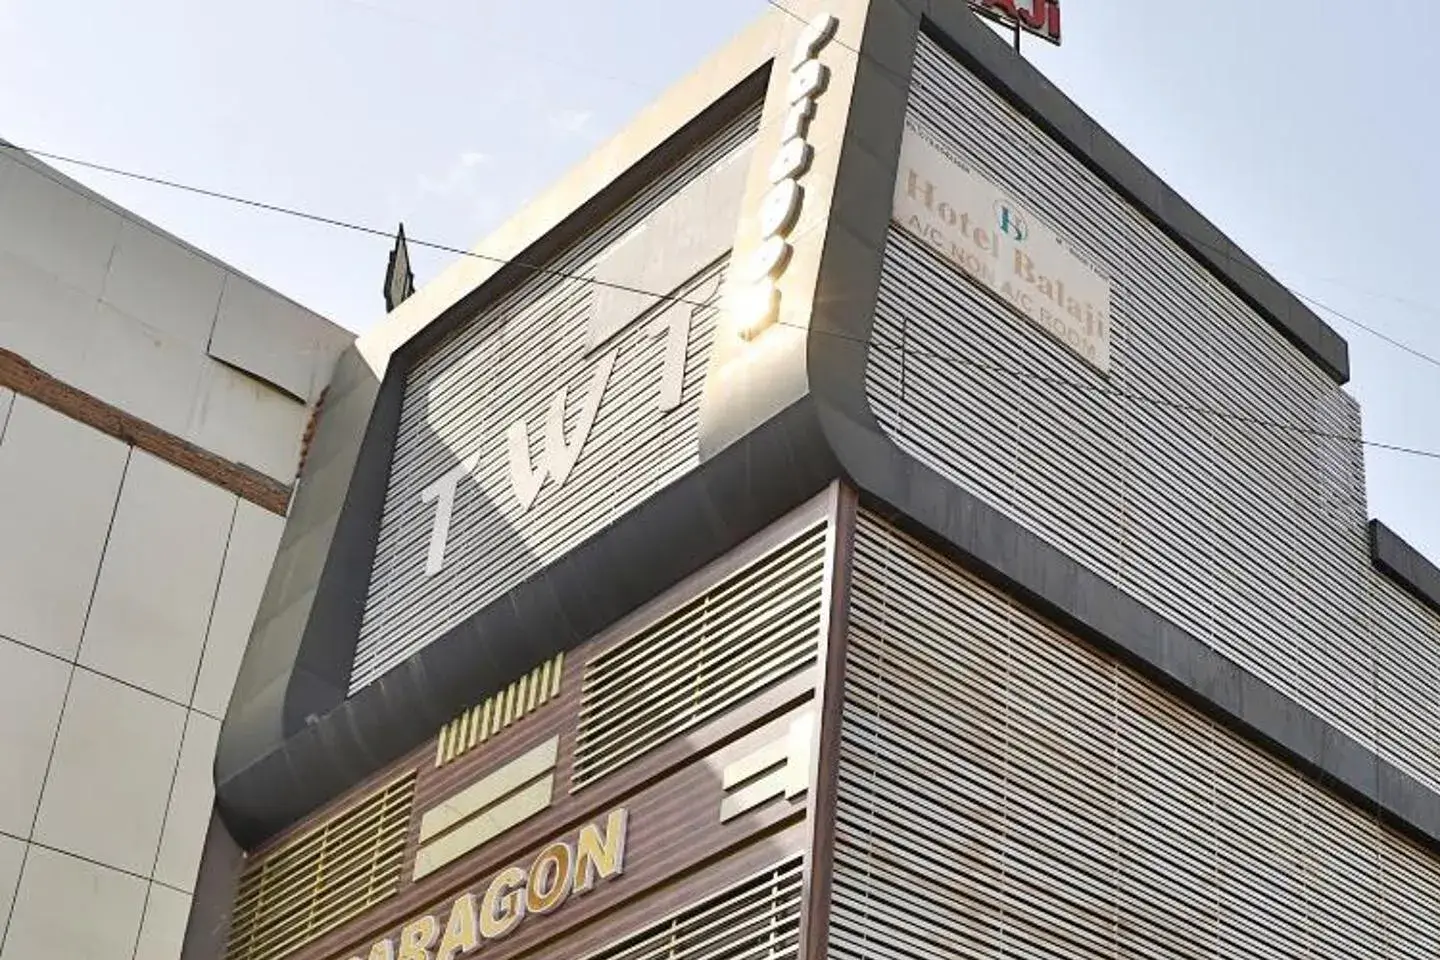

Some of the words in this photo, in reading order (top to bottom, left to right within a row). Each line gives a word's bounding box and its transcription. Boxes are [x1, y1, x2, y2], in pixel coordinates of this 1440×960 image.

[905, 168, 999, 259] Hotel
[1012, 247, 1106, 340] Balaji
[422, 272, 724, 578] TWT
